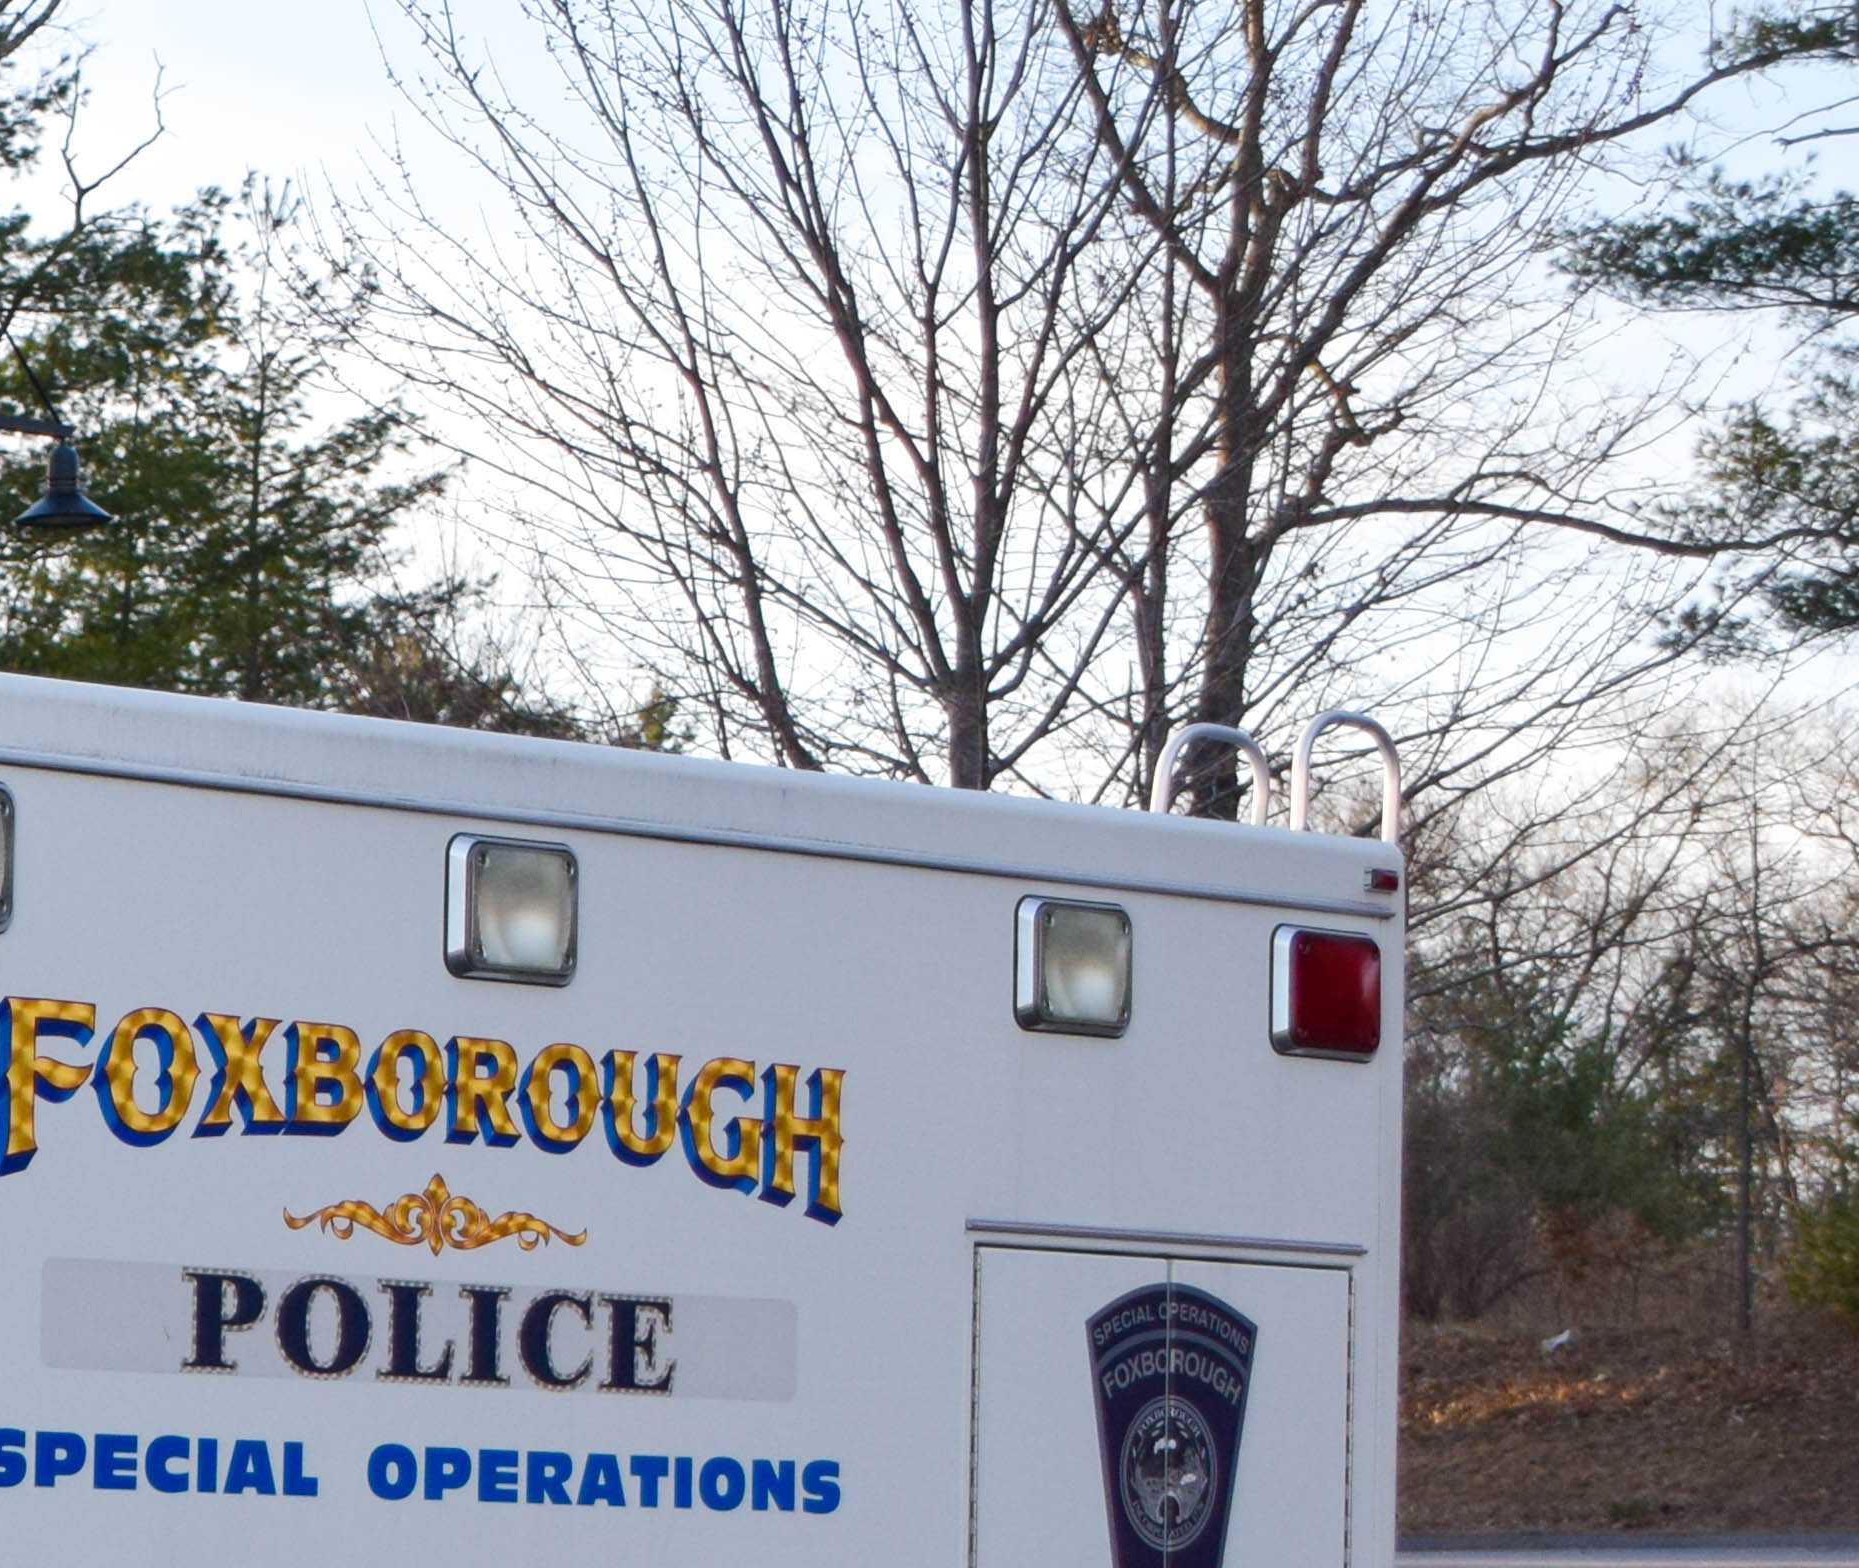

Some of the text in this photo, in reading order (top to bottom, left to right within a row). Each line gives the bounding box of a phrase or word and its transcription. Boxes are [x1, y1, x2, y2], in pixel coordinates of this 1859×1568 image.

[180, 1265, 677, 1398] POLICE
[1093, 1301, 1250, 1355] SPECIAL OPERATIONS
[1101, 1348, 1243, 1406] FOXBOROUGH
[366, 1442, 841, 1515] OPERATIONS
